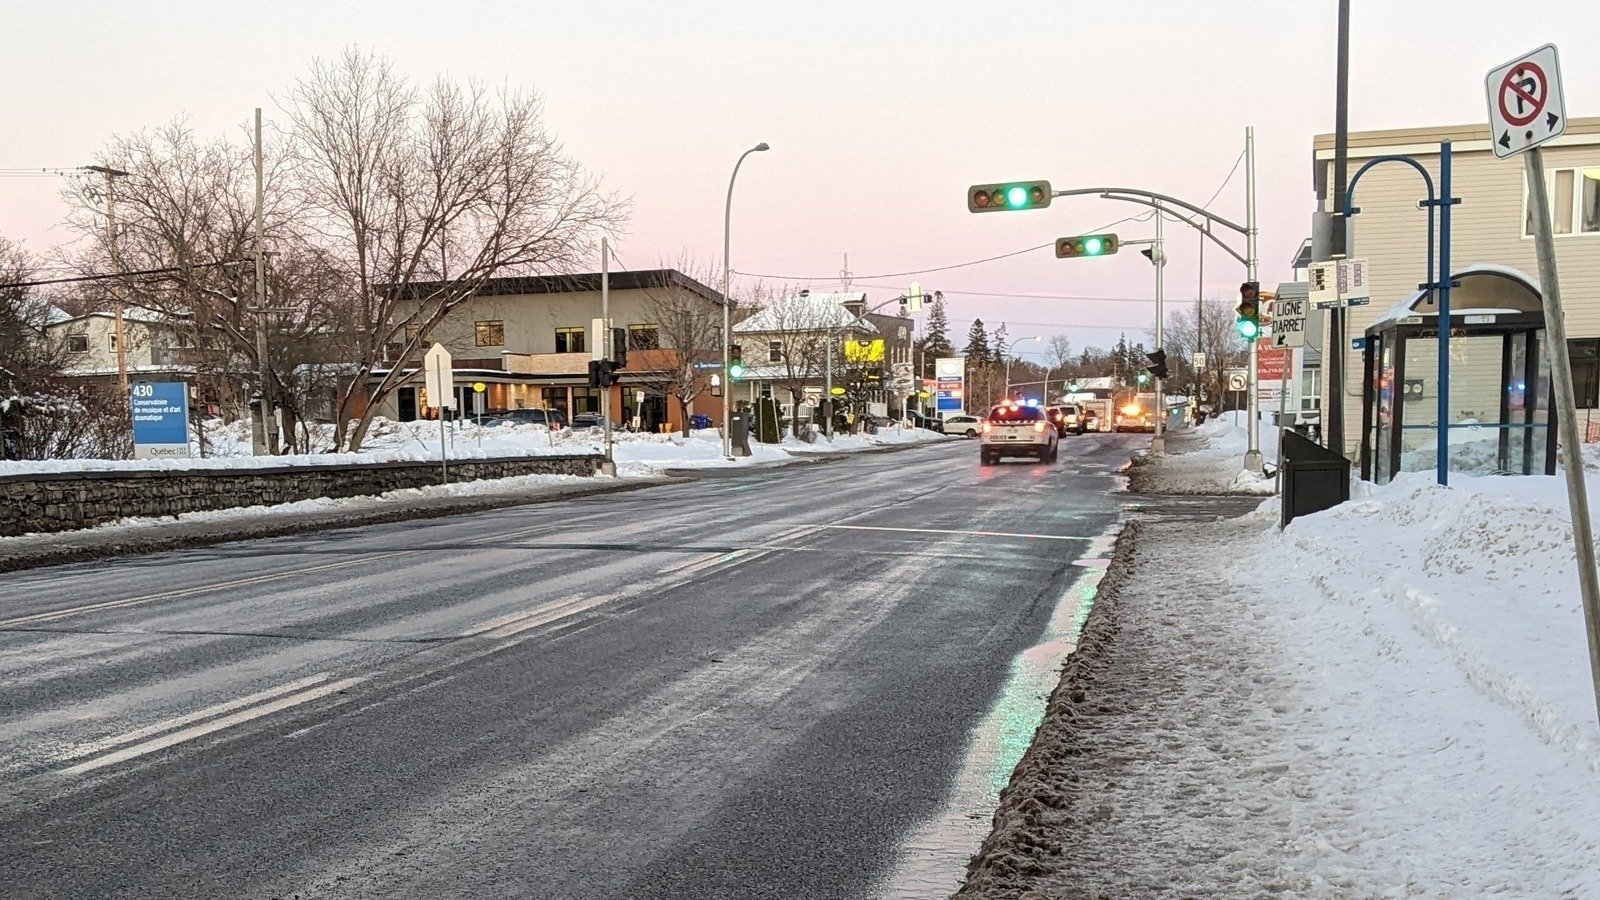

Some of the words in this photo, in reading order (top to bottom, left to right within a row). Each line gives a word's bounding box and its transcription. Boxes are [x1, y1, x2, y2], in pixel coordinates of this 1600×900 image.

[1277, 301, 1302, 316] LIGNE
[1194, 357, 1204, 366] 50
[133, 385, 153, 397] 430
[141, 407, 163, 415] musique
[150, 447, 176, 456] Québec
